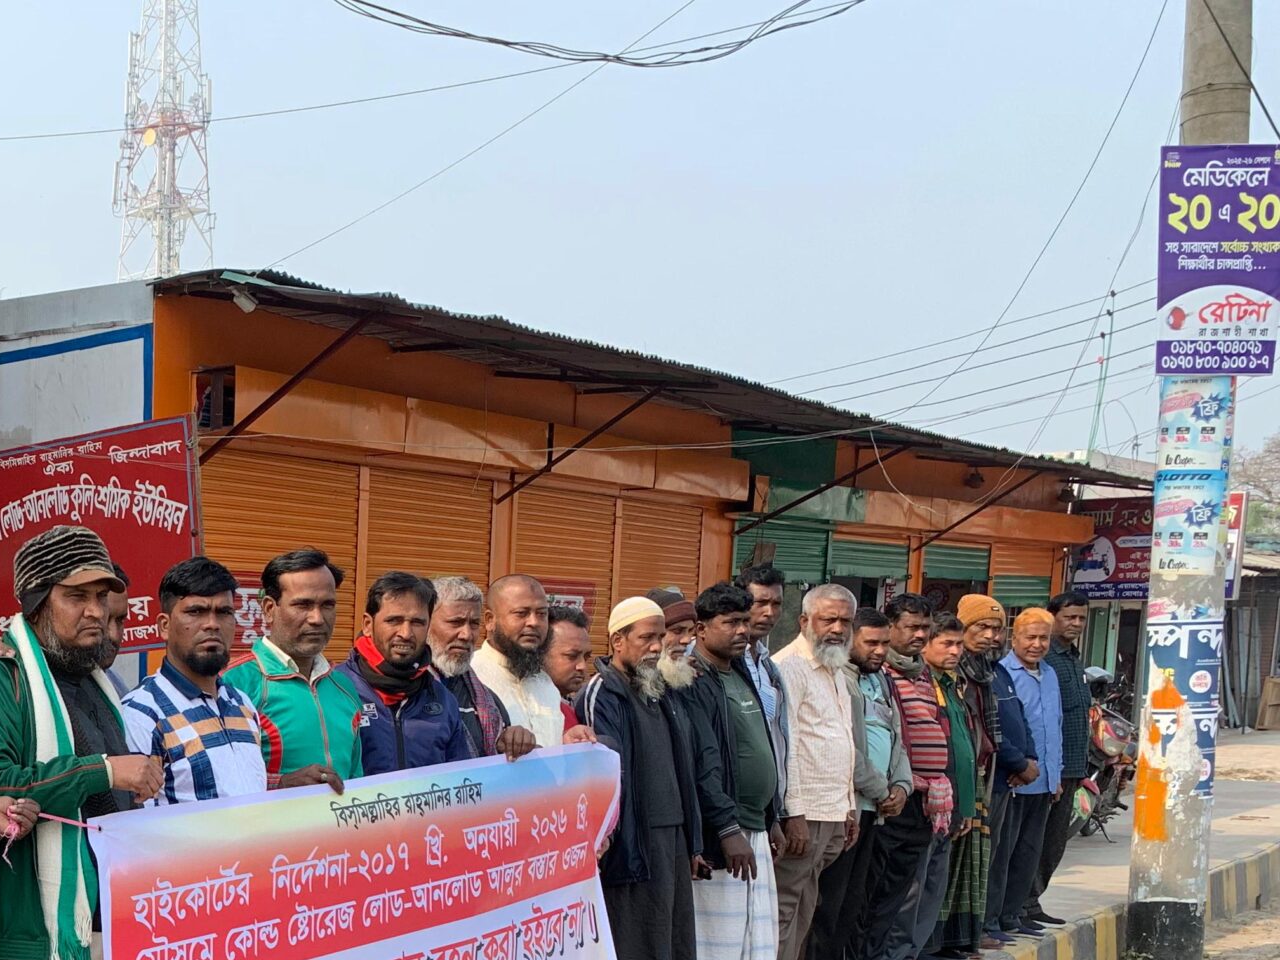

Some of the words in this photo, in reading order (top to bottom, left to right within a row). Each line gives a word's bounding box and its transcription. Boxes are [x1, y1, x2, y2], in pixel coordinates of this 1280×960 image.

[1183, 160, 1271, 187] মেডিকেলে
[1168, 192, 1212, 234] ২০
[1218, 203, 1231, 223] এ
[1237, 192, 1280, 234] ২০
[1165, 241, 1179, 254] সহ
[1198, 293, 1273, 324] রেটিনা
[42, 460, 75, 477] ঐক্য
[108, 439, 183, 465] জিন্দাবাদ
[1163, 473, 1213, 481] LOTTO
[70, 473, 96, 524] কুলি
[95, 475, 132, 520] শ্রমিক
[132, 479, 189, 535] ইউনিয়ন
[1190, 504, 1213, 522] ফ্রি
[453, 777, 483, 805] রাহিম
[130, 860, 253, 932] হাইকোর্টের
[270, 841, 410, 900] নির্দেশনা-২০১৭
[462, 807, 520, 860] অনুযায়ী
[531, 808, 568, 842] ২০২৬
[362, 869, 484, 928] লোড-আনলোড
[487, 859, 526, 898] আলুর
[528, 849, 560, 882] বস্তার
[561, 841, 590, 871] ওজন
